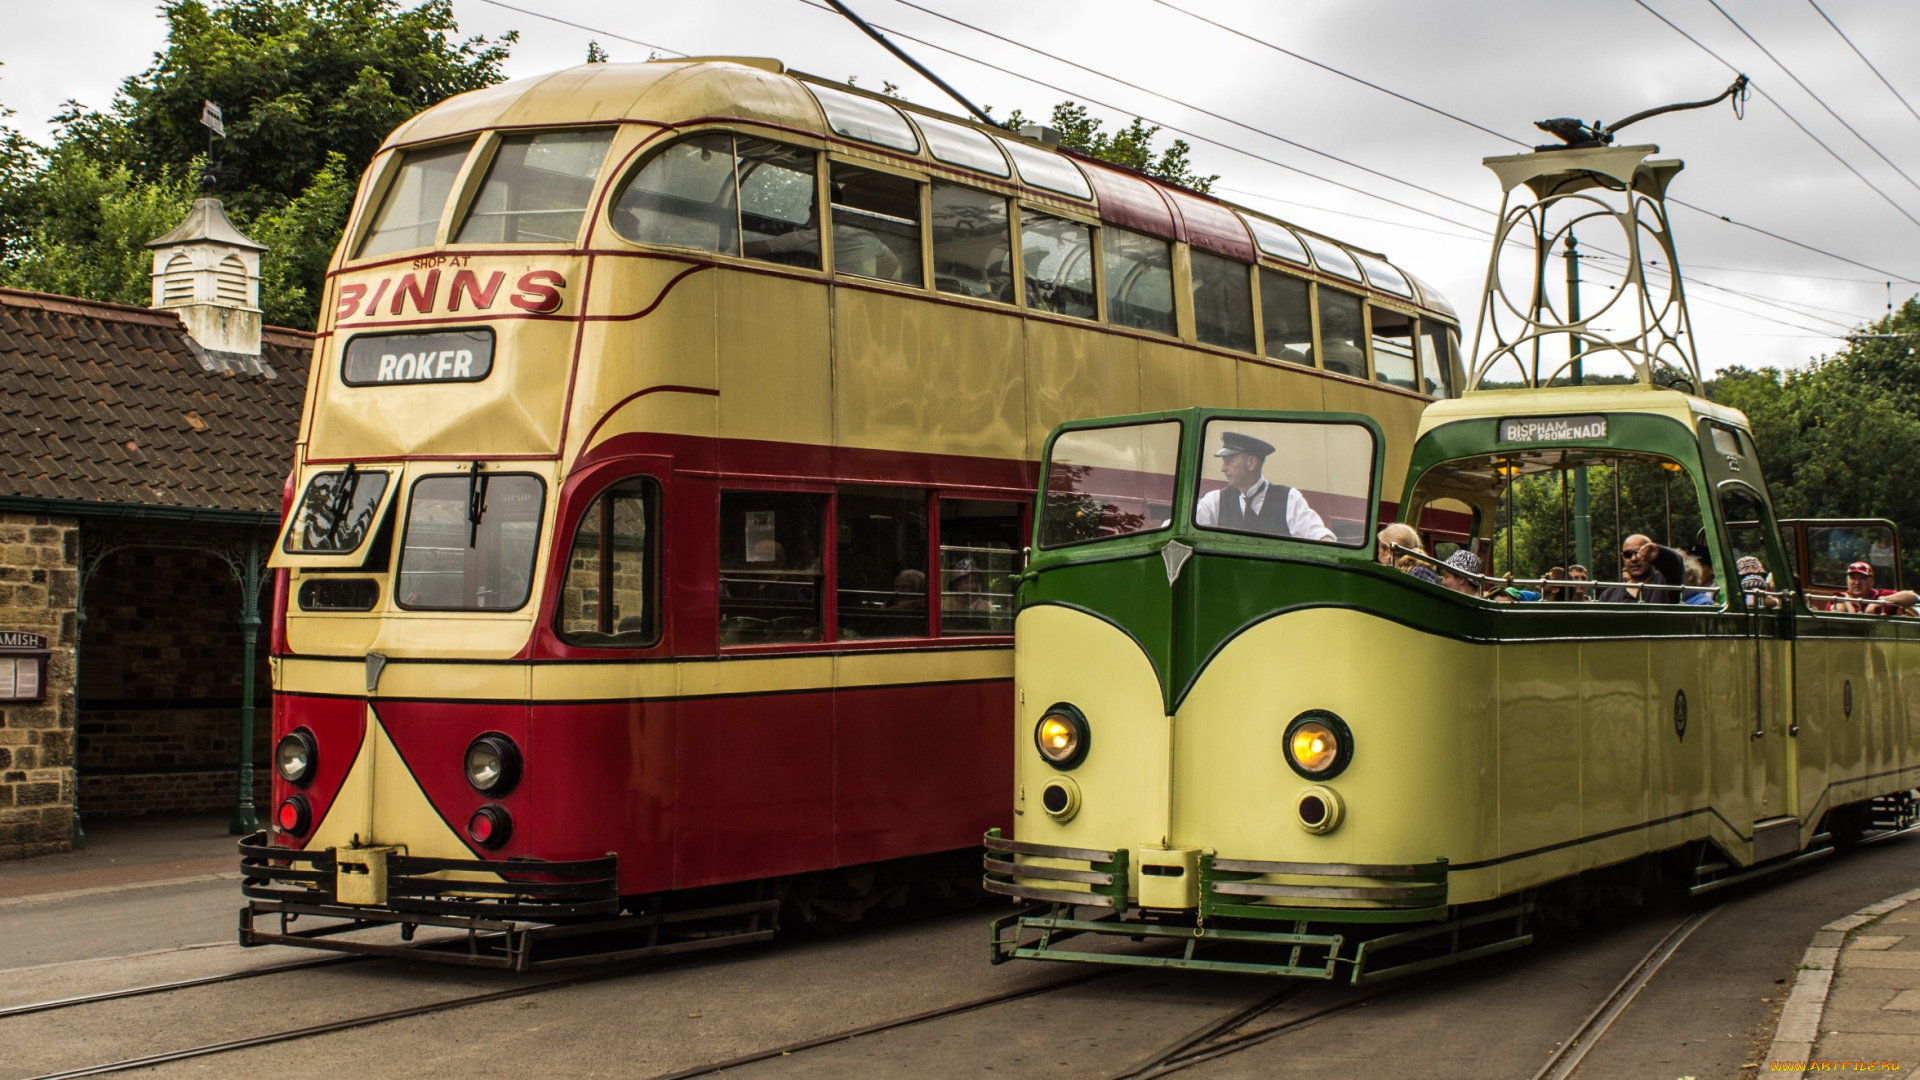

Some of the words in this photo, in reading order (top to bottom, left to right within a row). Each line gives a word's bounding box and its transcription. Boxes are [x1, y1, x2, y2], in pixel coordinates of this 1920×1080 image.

[413, 257, 447, 271] SHOP
[449, 256, 471, 267] AT
[336, 268, 566, 320] BINNS
[377, 349, 473, 381] ROKER
[1507, 420, 1568, 441] BISPHAM
[1538, 421, 1607, 441] PROMENADE
